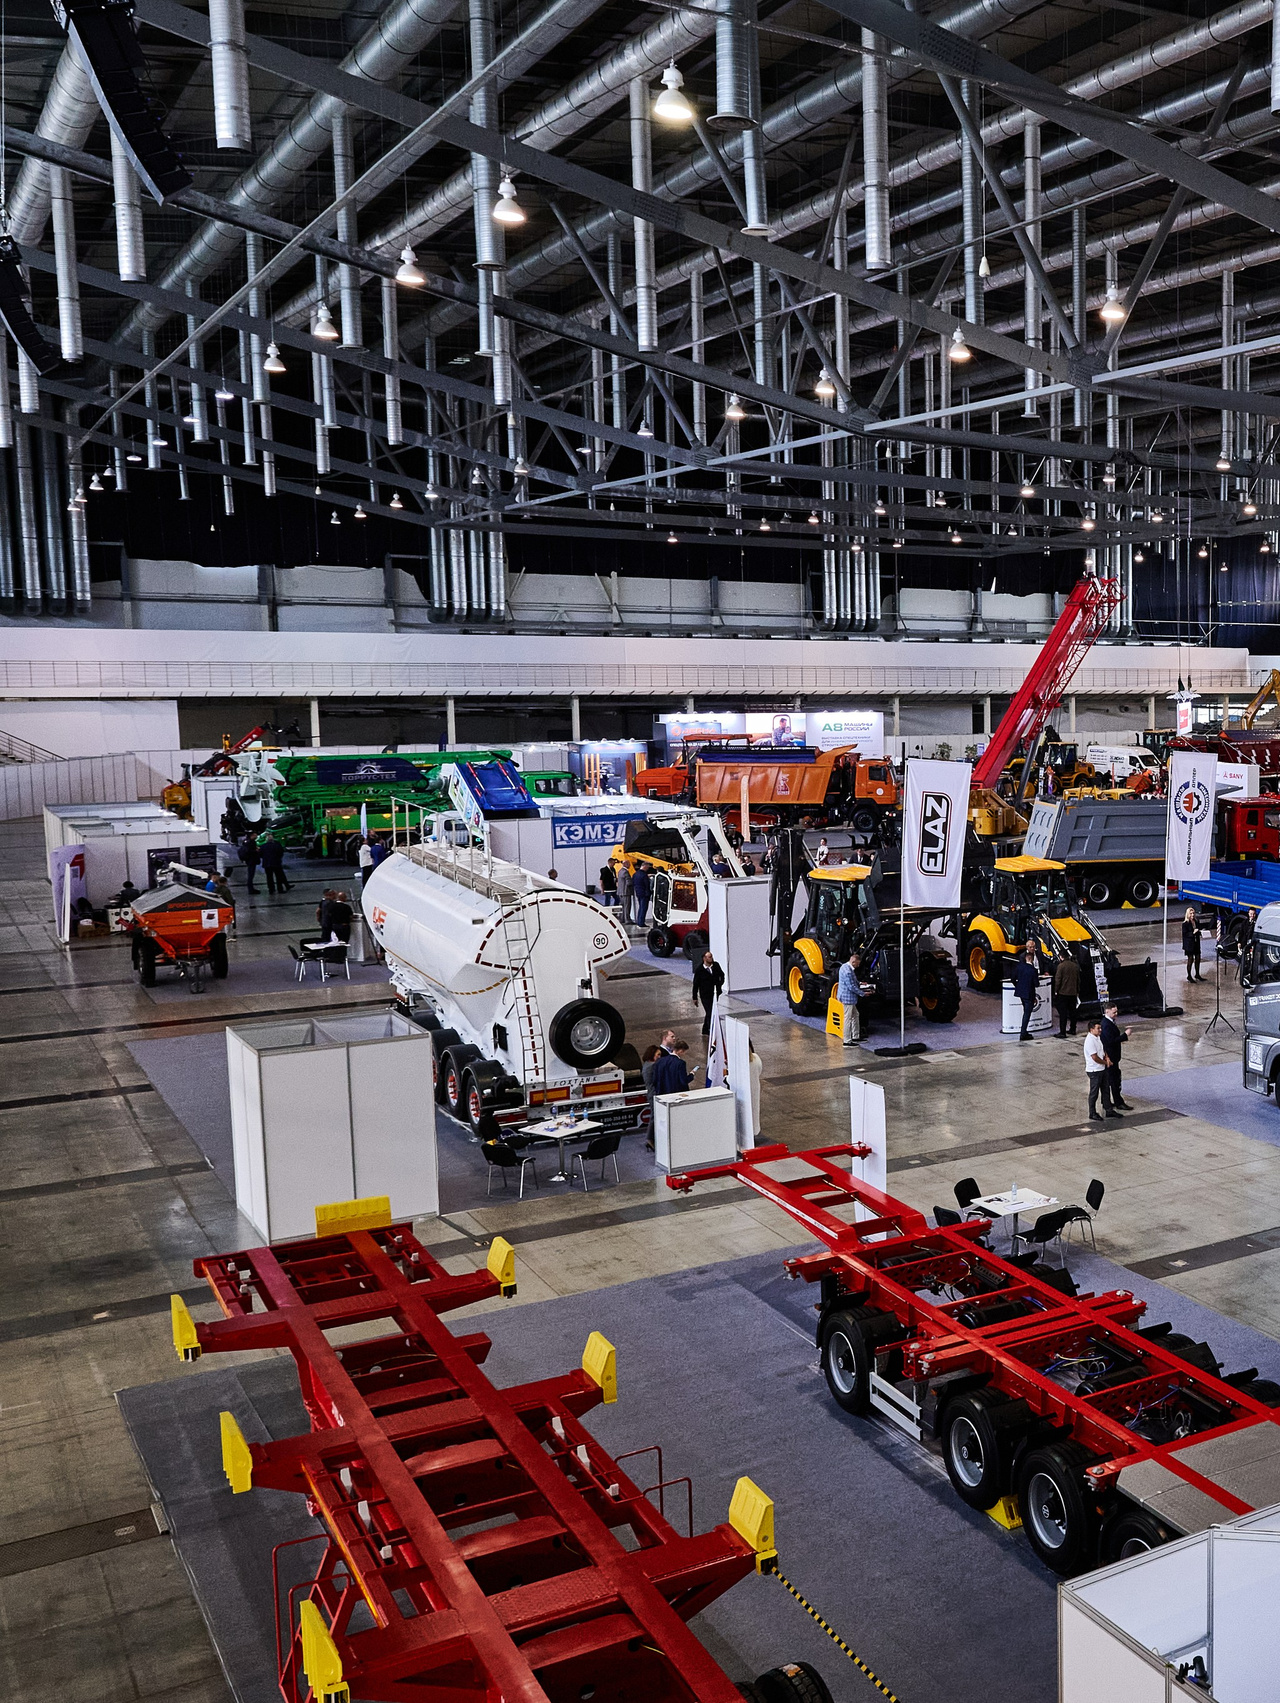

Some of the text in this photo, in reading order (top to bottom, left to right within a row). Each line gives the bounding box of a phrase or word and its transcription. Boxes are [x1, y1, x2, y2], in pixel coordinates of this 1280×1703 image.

[922, 796, 948, 872] ELAZ
[595, 937, 606, 945] 90
[553, 1076, 598, 1087] FOXTANK
